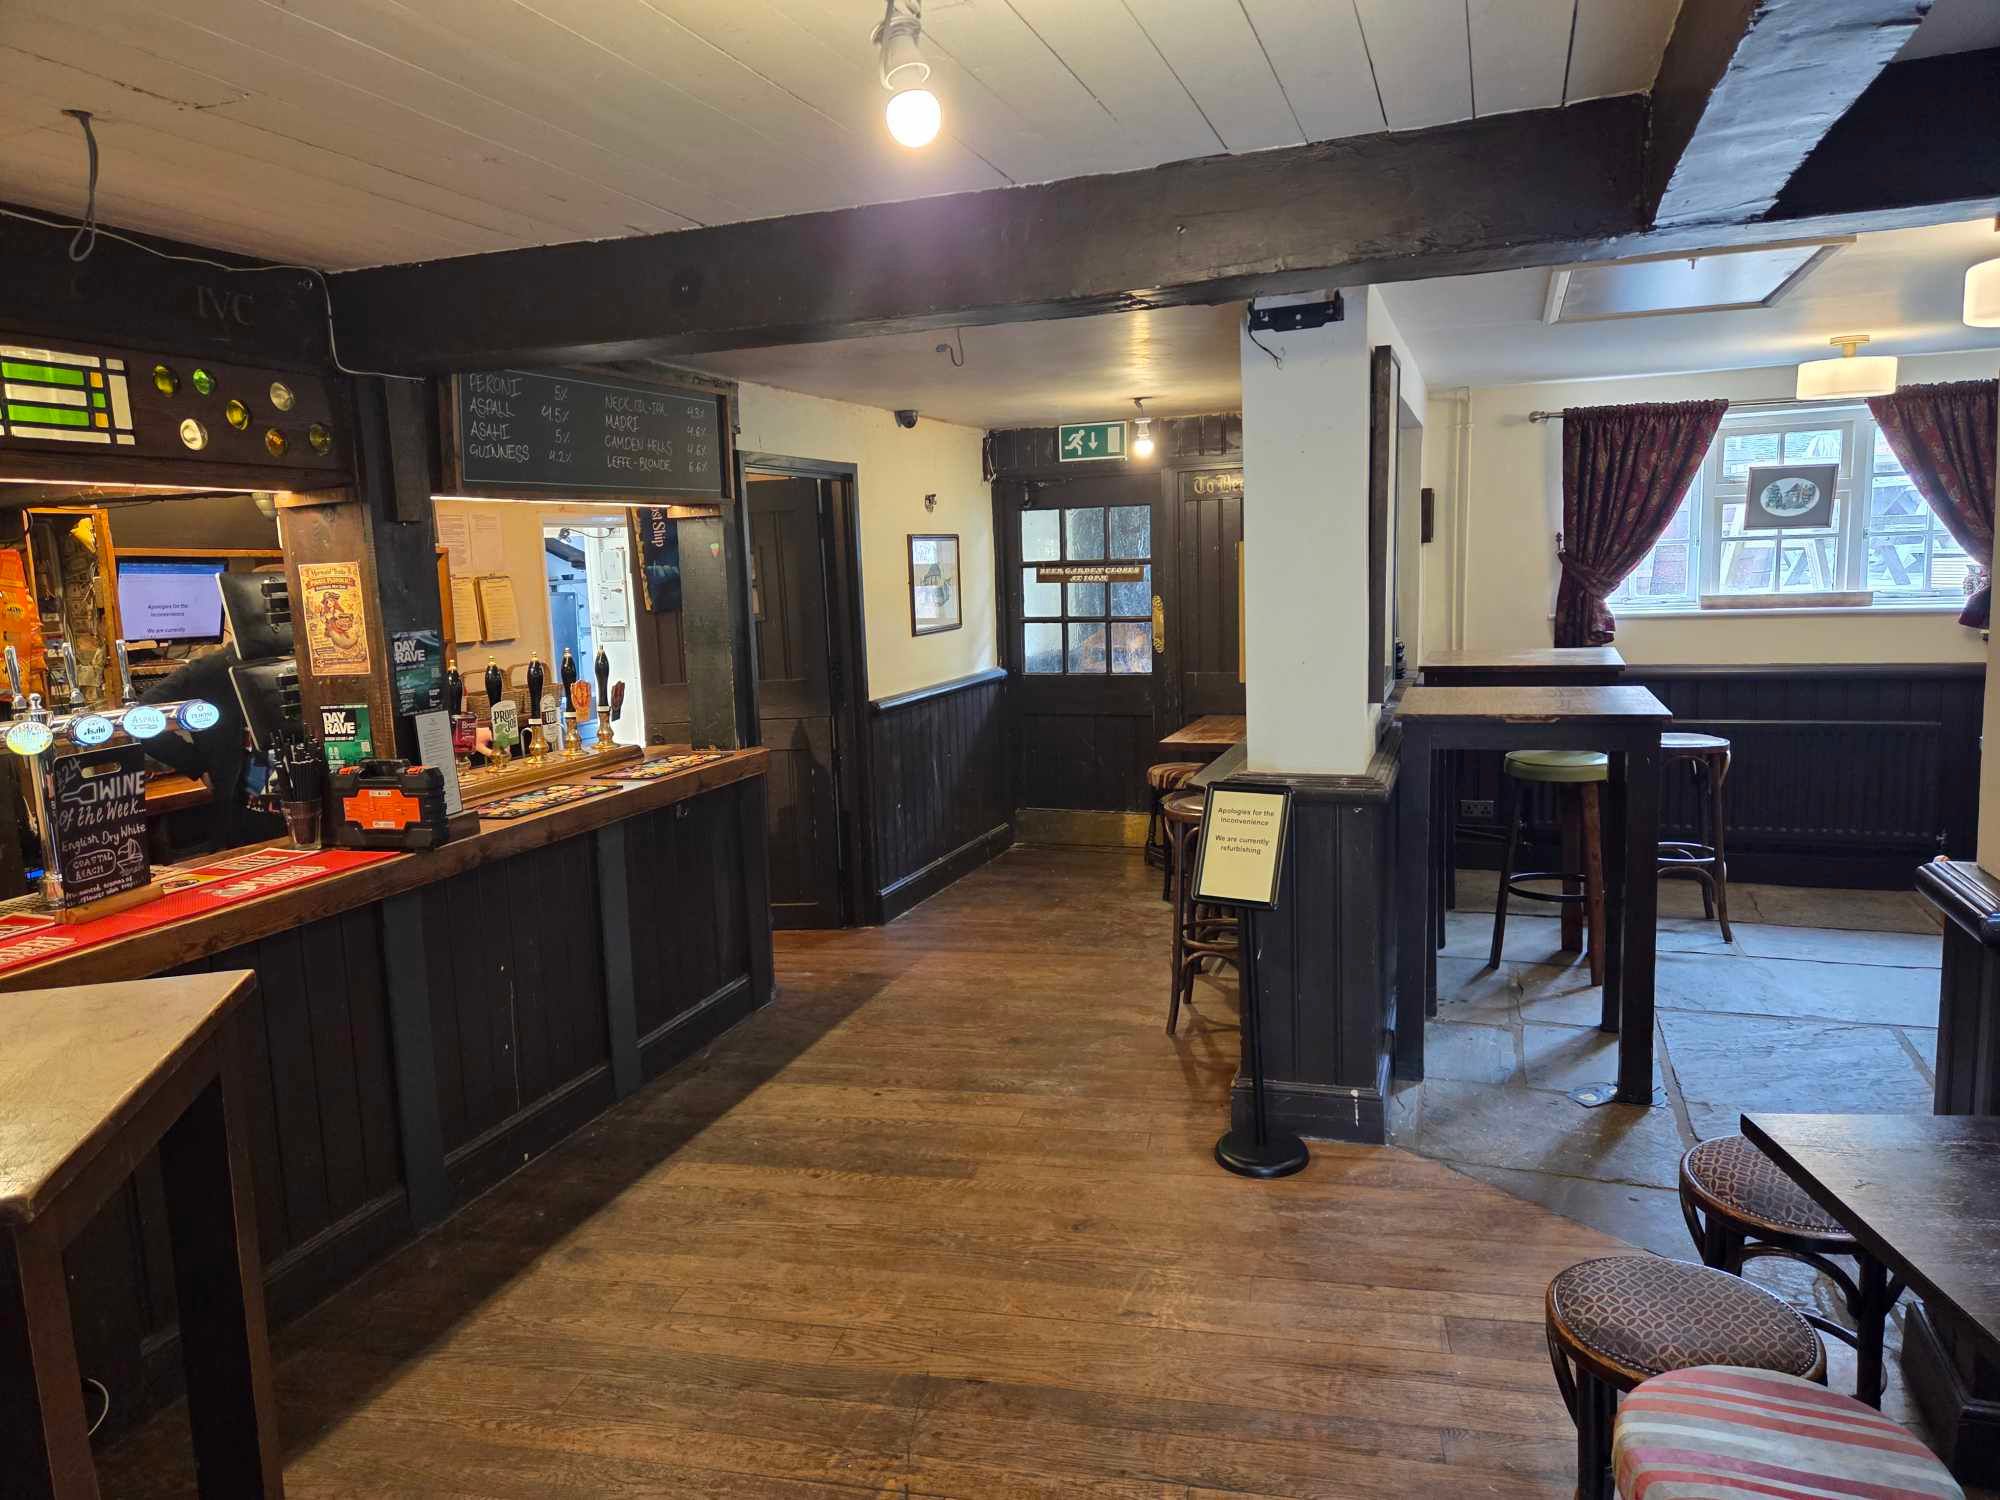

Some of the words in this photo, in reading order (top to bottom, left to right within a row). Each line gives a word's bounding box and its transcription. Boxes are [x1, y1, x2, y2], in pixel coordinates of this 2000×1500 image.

[469, 373, 523, 397] PERONI
[470, 396, 516, 418] ASPALL
[470, 420, 512, 441] ASAHI
[469, 443, 530, 464] GUINNESS
[394, 640, 417, 653] DAY
[394, 650, 426, 664] RAVE
[322, 711, 347, 725] DAY
[324, 722, 356, 735] RAVE
[100, 771, 146, 801] WINE
[77, 805, 104, 827] the
[1218, 807, 1251, 816] Apologies
[1263, 809, 1275, 817] the
[1220, 817, 1269, 826] inconvenience
[62, 834, 100, 855] English
[101, 830, 120, 846] Dry
[120, 823, 147, 838] White
[1215, 834, 1226, 842] We
[1238, 837, 1271, 846] currently
[1220, 845, 1262, 855] refurbishing
